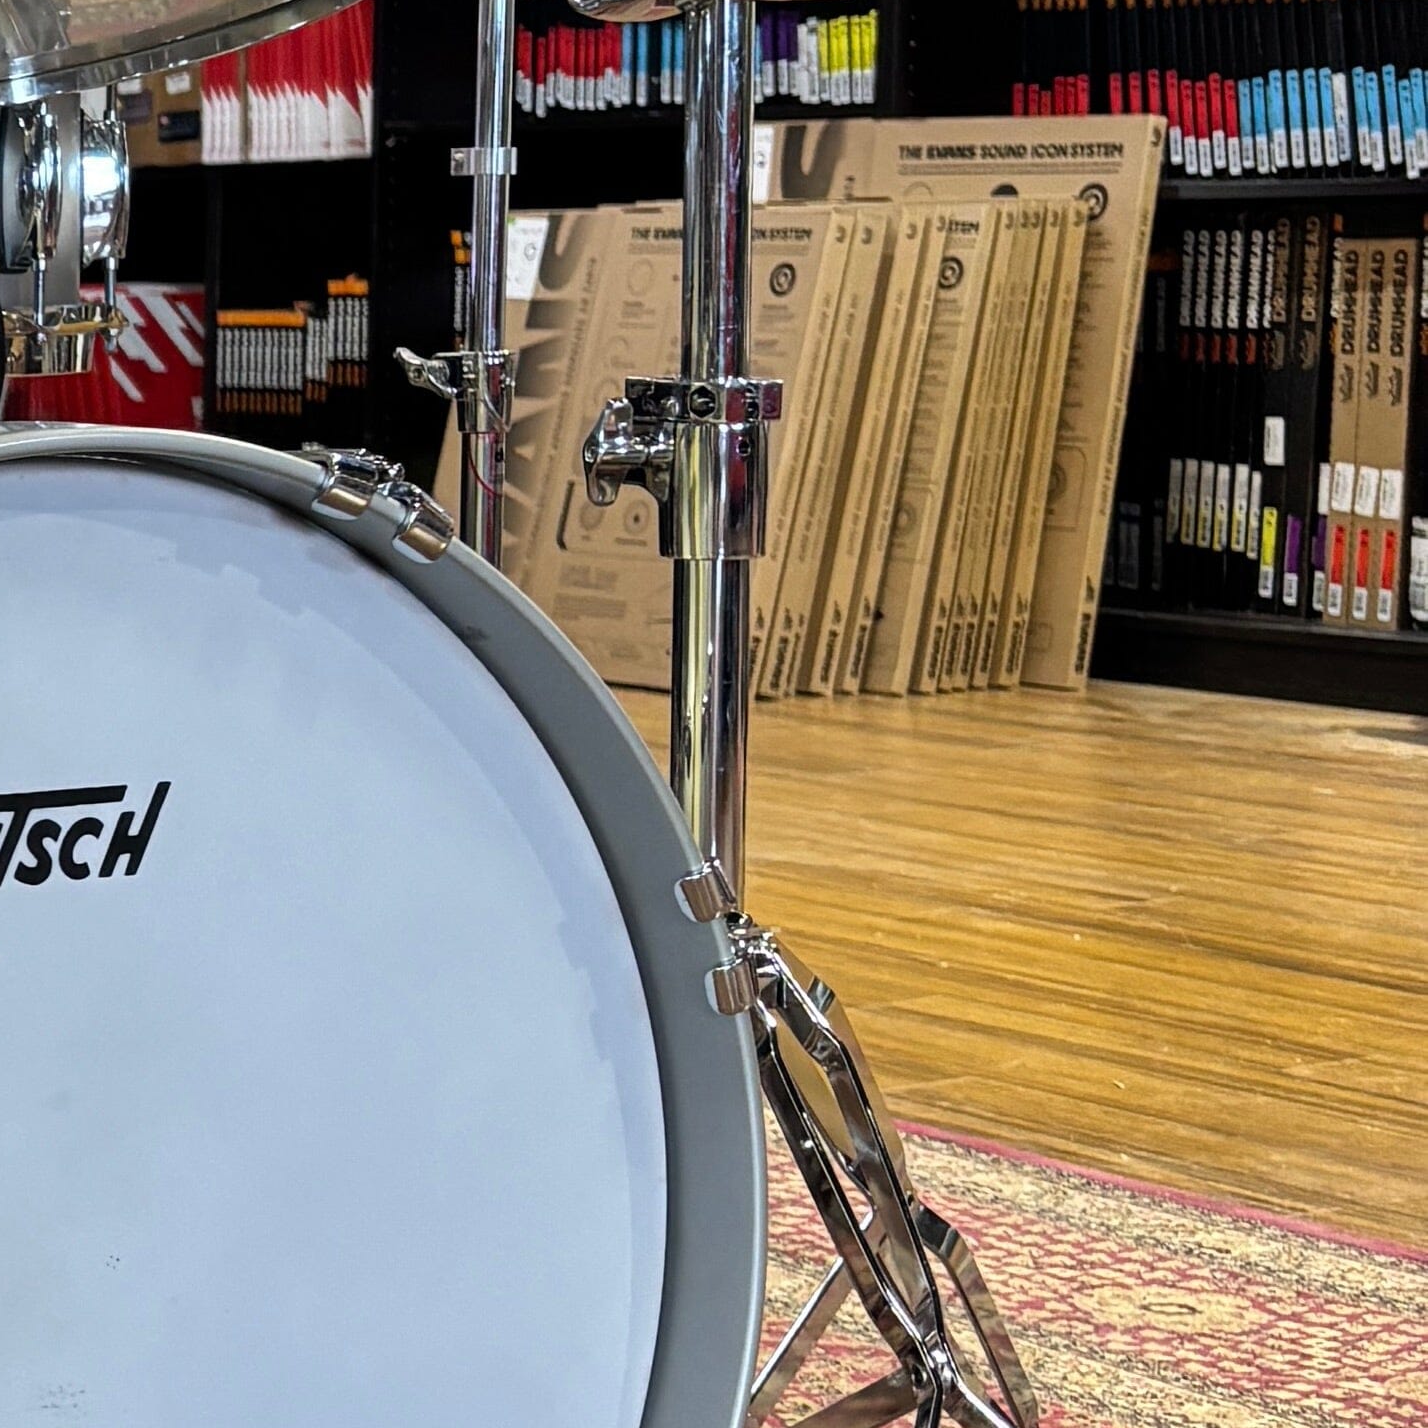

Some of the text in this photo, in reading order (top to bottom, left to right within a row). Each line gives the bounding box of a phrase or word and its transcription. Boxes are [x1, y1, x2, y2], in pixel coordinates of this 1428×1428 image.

[898, 145, 922, 160] THE
[980, 144, 1027, 159] SOUND
[1030, 143, 1068, 159] ICON
[1068, 142, 1124, 158] SYSTEM
[1180, 230, 1195, 328] DRUMHEAD
[1195, 230, 1210, 329] DRUMHEAD
[1211, 230, 1227, 329] DRUMHEAD
[1227, 230, 1243, 330] DRUMHEAD
[1246, 230, 1264, 330] DRUMHEAD
[1341, 250, 1360, 356] DRUMHEAD
[1367, 250, 1386, 354] DRUMHEAD
[1390, 249, 1409, 358] DRUMHEAD
